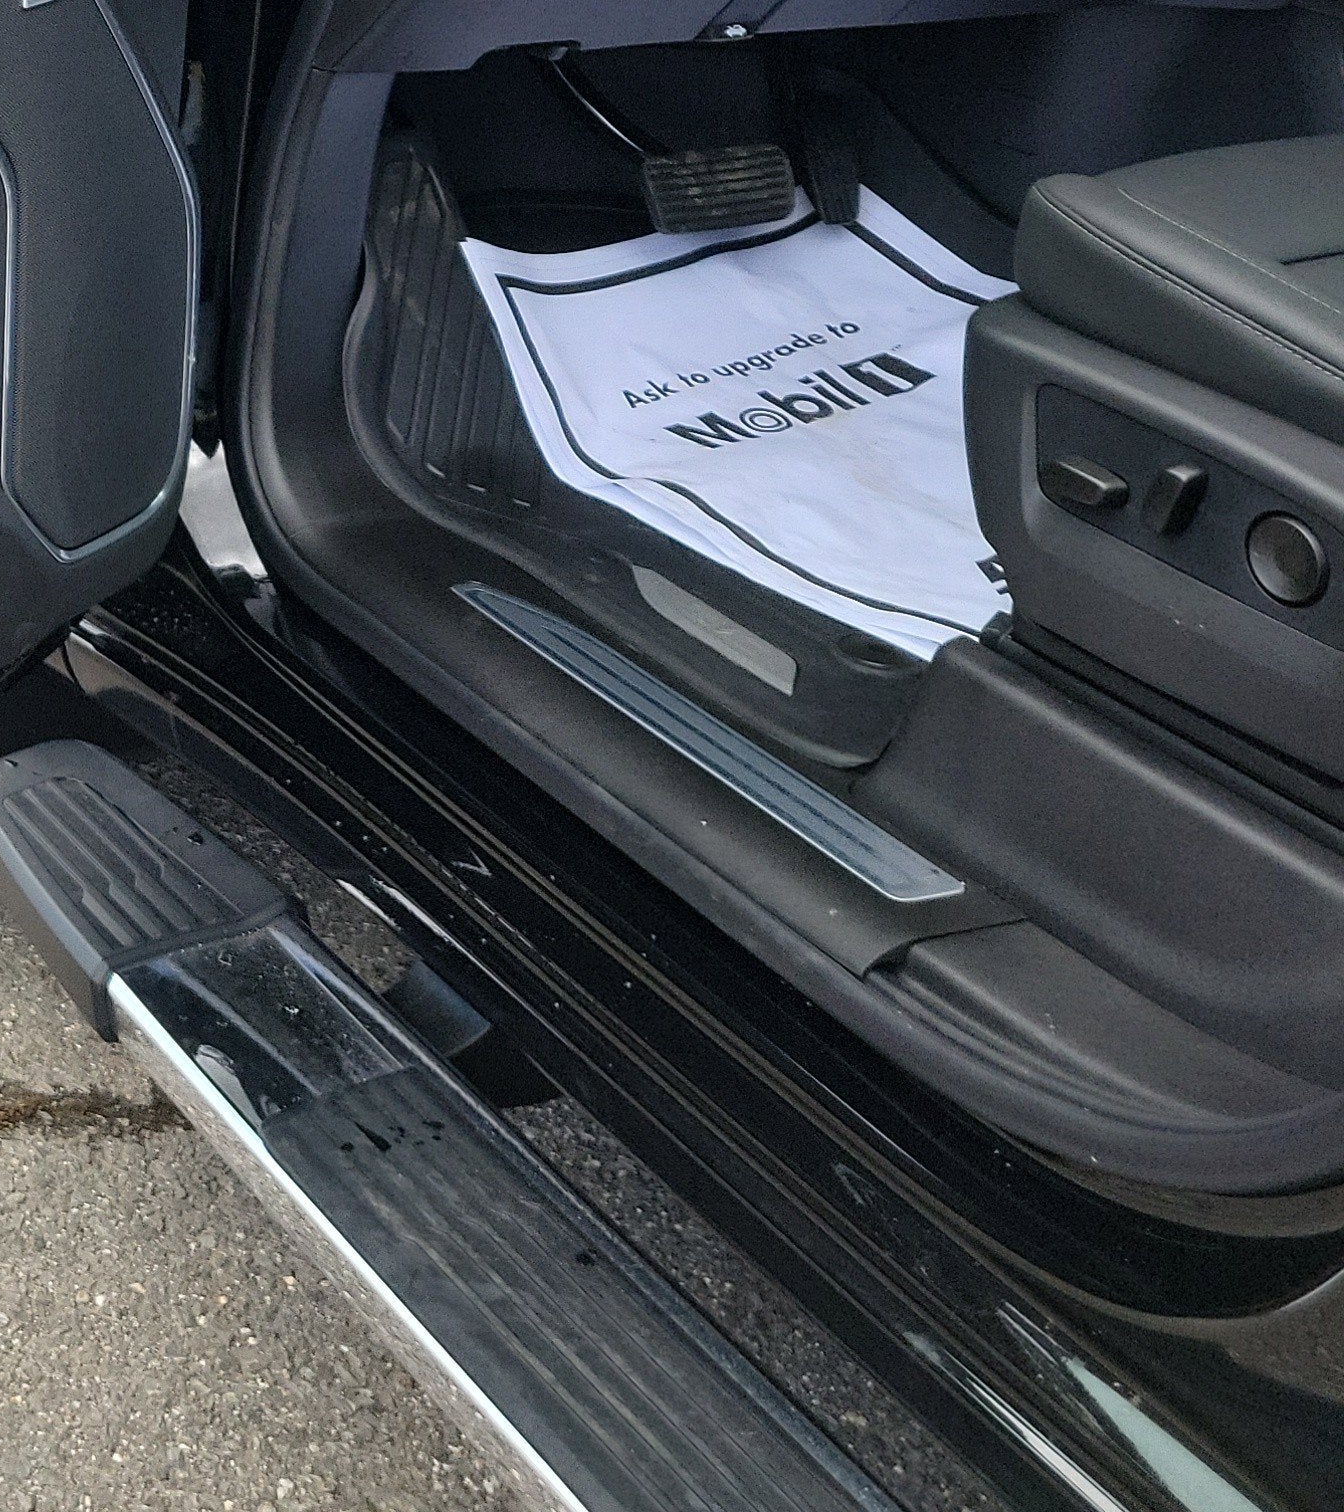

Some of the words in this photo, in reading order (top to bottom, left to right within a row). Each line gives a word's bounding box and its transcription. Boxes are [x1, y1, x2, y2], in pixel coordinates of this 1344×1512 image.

[622, 380, 677, 409] Ask
[677, 372, 711, 389] to
[712, 332, 829, 378] upgrade
[825, 320, 861, 340] to
[663, 368, 872, 449] Mobil
